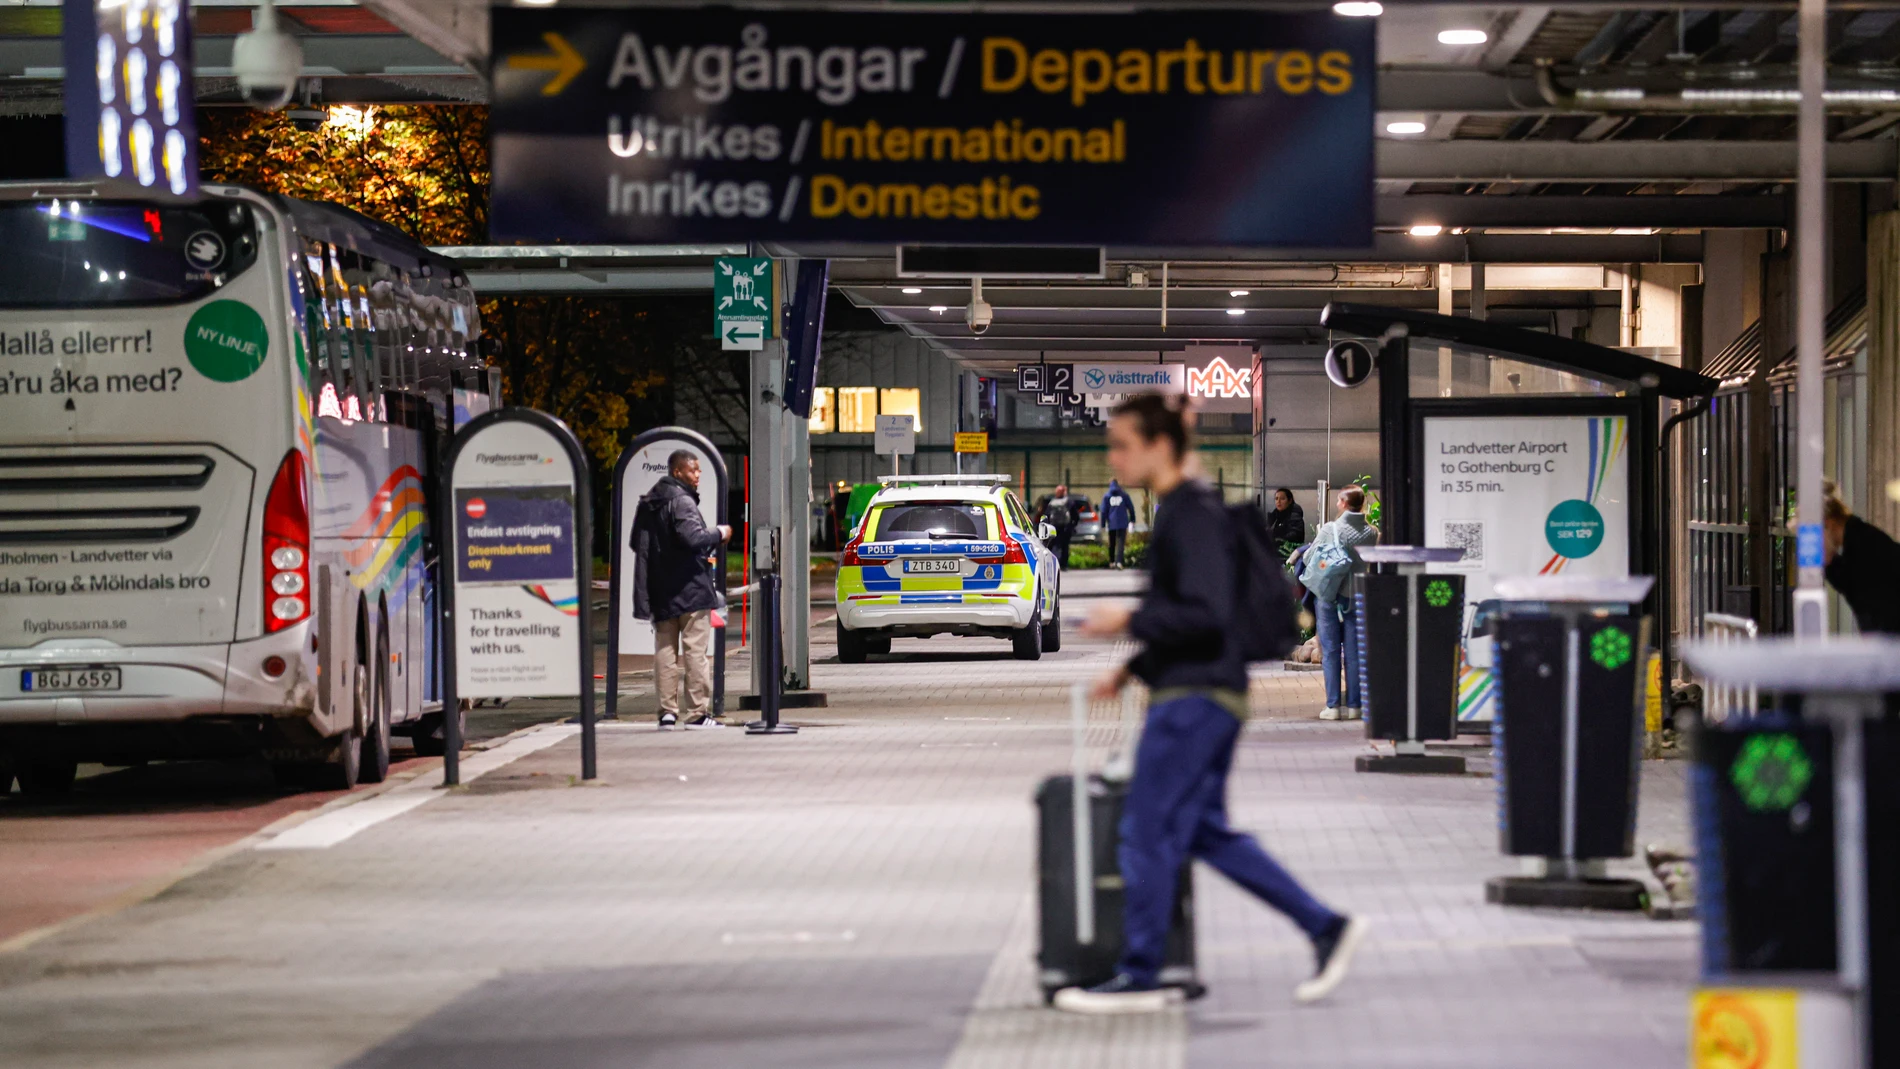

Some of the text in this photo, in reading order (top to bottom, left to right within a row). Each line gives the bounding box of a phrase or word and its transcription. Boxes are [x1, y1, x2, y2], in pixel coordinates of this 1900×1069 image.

[607, 24, 1353, 106] Avgångar / Departures
[608, 115, 782, 160] Utrikes
[821, 118, 1126, 162] International
[608, 172, 772, 217] Inrikes
[810, 175, 1040, 219] Domestic
[61, 330, 152, 354] ellerrr!
[197, 326, 259, 356] NY LINJE
[1340, 348, 1354, 379] 1
[0, 367, 182, 395] a'ru åka med?
[1054, 368, 1171, 390] 2 västtrafik
[1187, 356, 1251, 398] MAX
[1441, 441, 1568, 455] Landvetter Airport
[1441, 460, 1554, 475] to Gothenburg C
[1441, 480, 1504, 492] in 35 min.
[467, 524, 563, 539] Endast avstigning
[1576, 530, 1592, 538] 129
[70, 550, 149, 563] Landvetter
[152, 550, 173, 562] via
[468, 543, 552, 556] Disembarkment
[867, 545, 894, 554] POLIS
[468, 557, 492, 572] only
[912, 561, 955, 570] ZTB 340
[26, 576, 66, 595] Torg
[71, 576, 85, 592] &
[90, 574, 174, 592] Mölndals
[178, 574, 211, 589] bro
[470, 607, 522, 620] Thanks
[23, 618, 128, 634] flygbussarna.se
[470, 623, 561, 638] for travelling
[470, 642, 524, 654] with us.
[38, 672, 113, 688] BGJ 659
